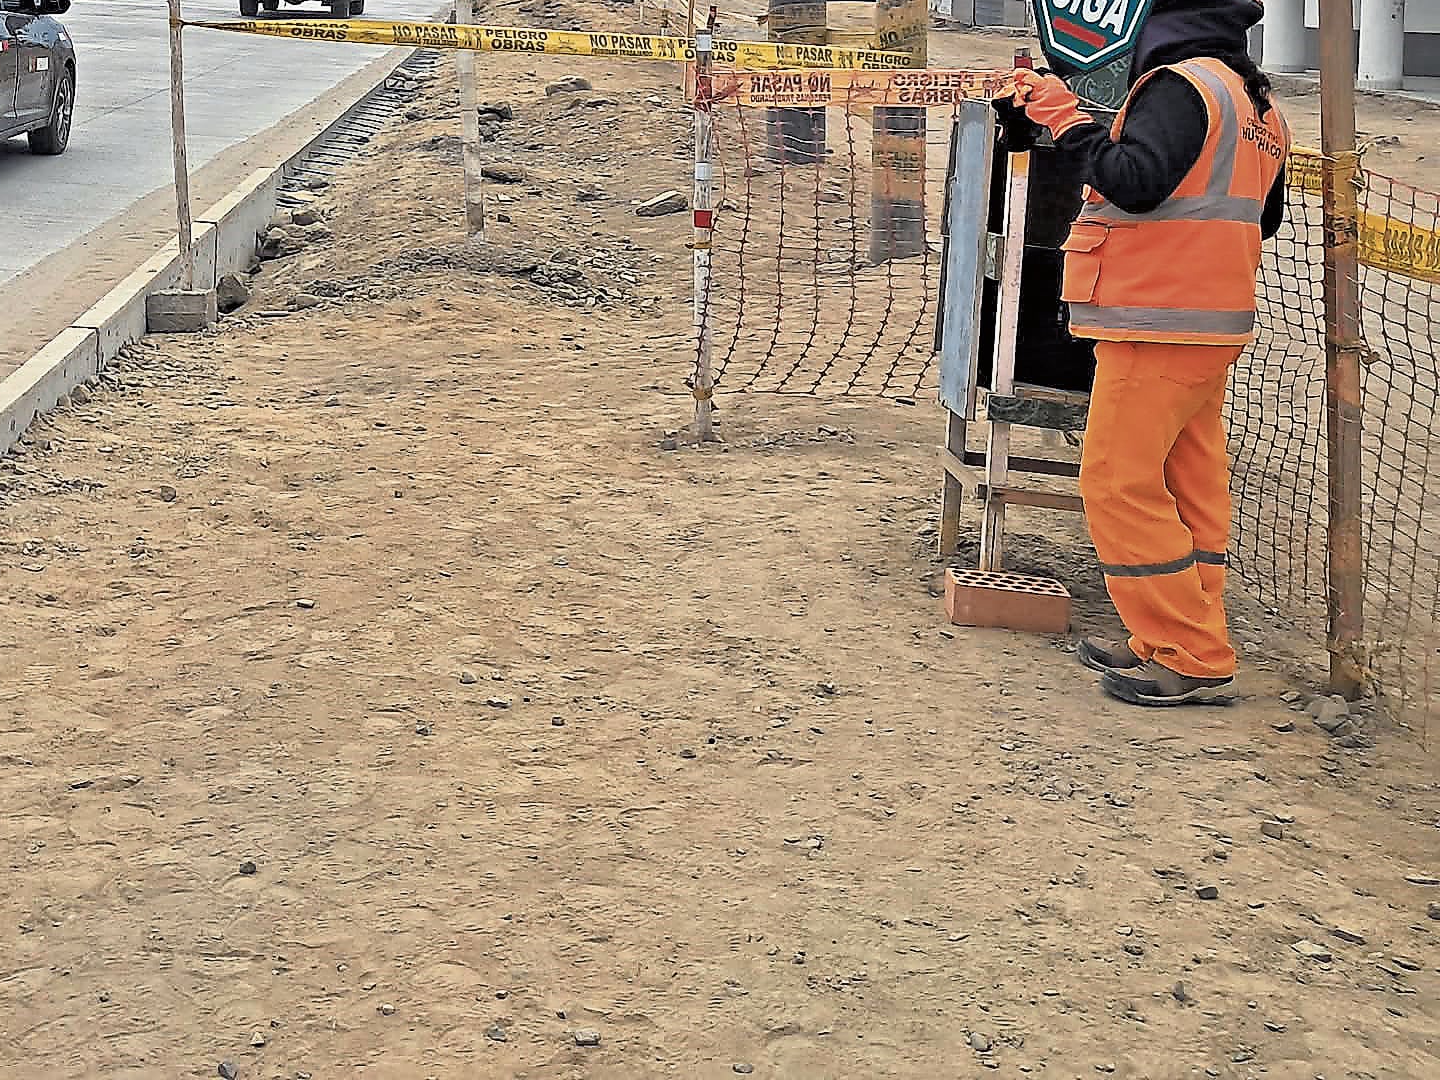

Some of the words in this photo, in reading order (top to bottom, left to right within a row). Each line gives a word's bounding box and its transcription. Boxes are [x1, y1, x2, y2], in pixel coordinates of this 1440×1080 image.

[291, 27, 347, 39] OBRAS
[392, 25, 411, 39] NO
[416, 26, 458, 40] PASAR
[486, 29, 548, 41] PELIGRO
[491, 39, 545, 51] OBRAS
[589, 34, 608, 48] NO
[611, 36, 652, 50] PASAR
[678, 39, 738, 51] PEGRO
[796, 47, 833, 62] PASAR
[857, 51, 911, 65] PELIGRO
